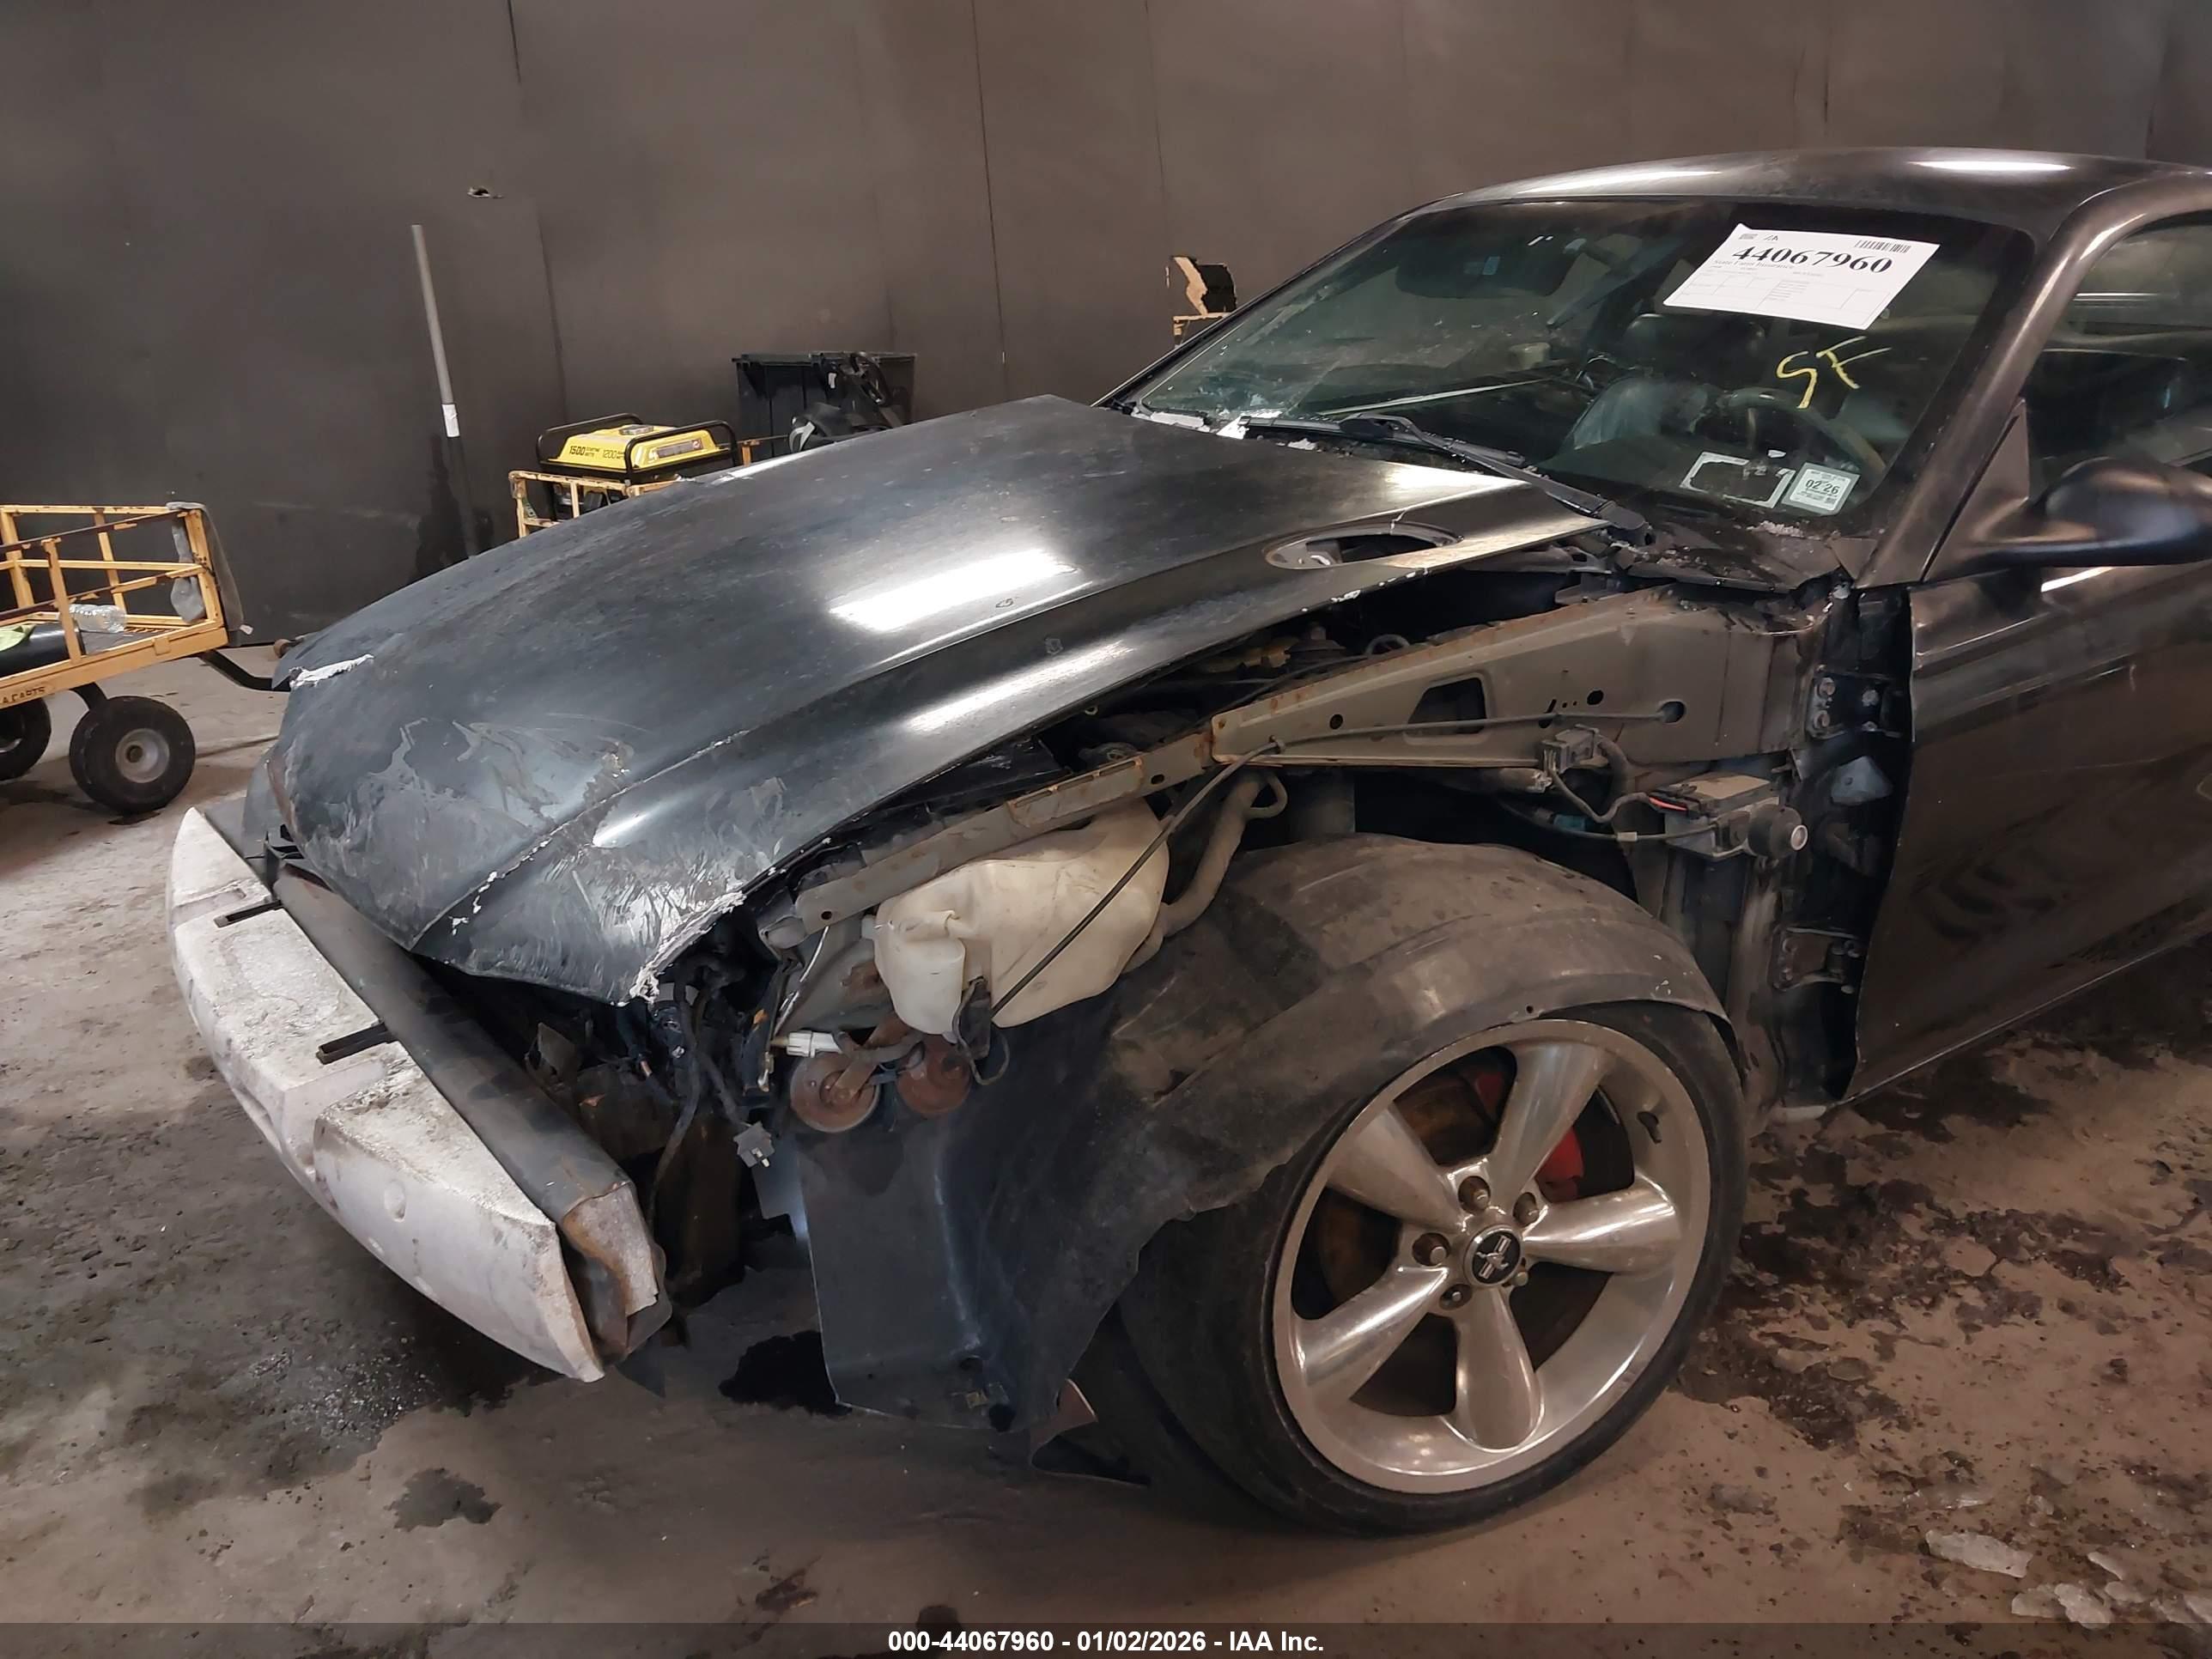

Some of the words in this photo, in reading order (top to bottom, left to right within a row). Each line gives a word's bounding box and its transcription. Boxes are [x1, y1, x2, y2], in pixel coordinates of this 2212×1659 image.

[1732, 246, 1893, 273] 44067960
[1776, 336, 1893, 410] SF
[569, 446, 586, 456] 1500
[603, 449, 617, 459] 1200
[1805, 479, 1822, 489] 02
[1823, 483, 1840, 495] 26
